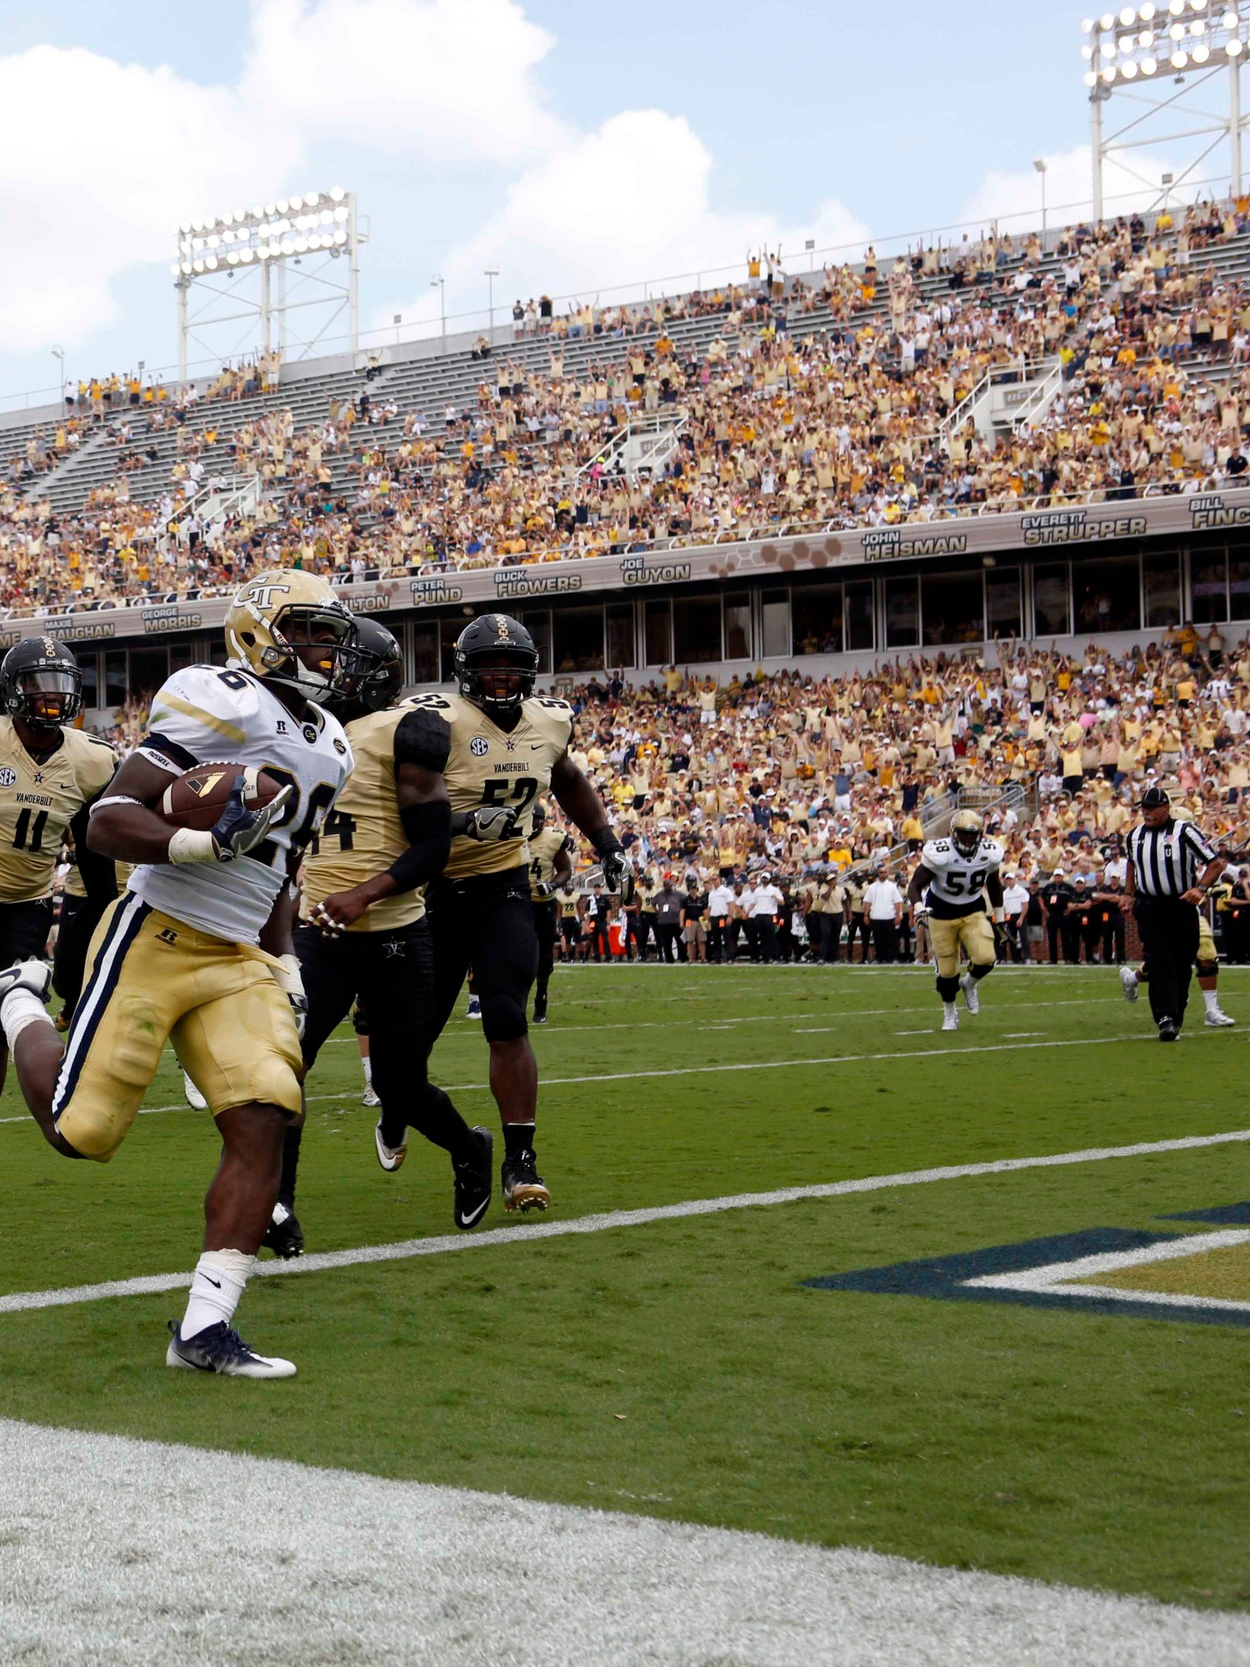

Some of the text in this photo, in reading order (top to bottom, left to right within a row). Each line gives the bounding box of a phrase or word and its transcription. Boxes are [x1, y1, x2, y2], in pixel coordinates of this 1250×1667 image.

[1190, 497, 1224, 512] BILL
[1021, 510, 1087, 529] EVERETT
[861, 531, 900, 545] JOHN
[1024, 518, 1147, 545] STRUPPER
[865, 535, 967, 561] HEISMAN
[620, 558, 644, 571] JOE
[494, 570, 527, 583] BUCK
[623, 565, 691, 585] GUYON
[410, 580, 445, 593] PETER
[498, 576, 582, 597] FLOWERS
[413, 587, 462, 605] PUND
[141, 607, 178, 621] GEORGE
[44, 619, 72, 630] MAXIE
[145, 614, 201, 633] MORRIS
[47, 624, 115, 642] BAUGHAN
[471, 739, 488, 755] SEC
[147, 750, 170, 767] RUSSELL
[494, 762, 530, 774] VANDERBILT
[16, 792, 53, 806] VANDERBILT
[479, 777, 538, 837] 52
[12, 808, 49, 853] 11
[943, 869, 987, 897] 58
